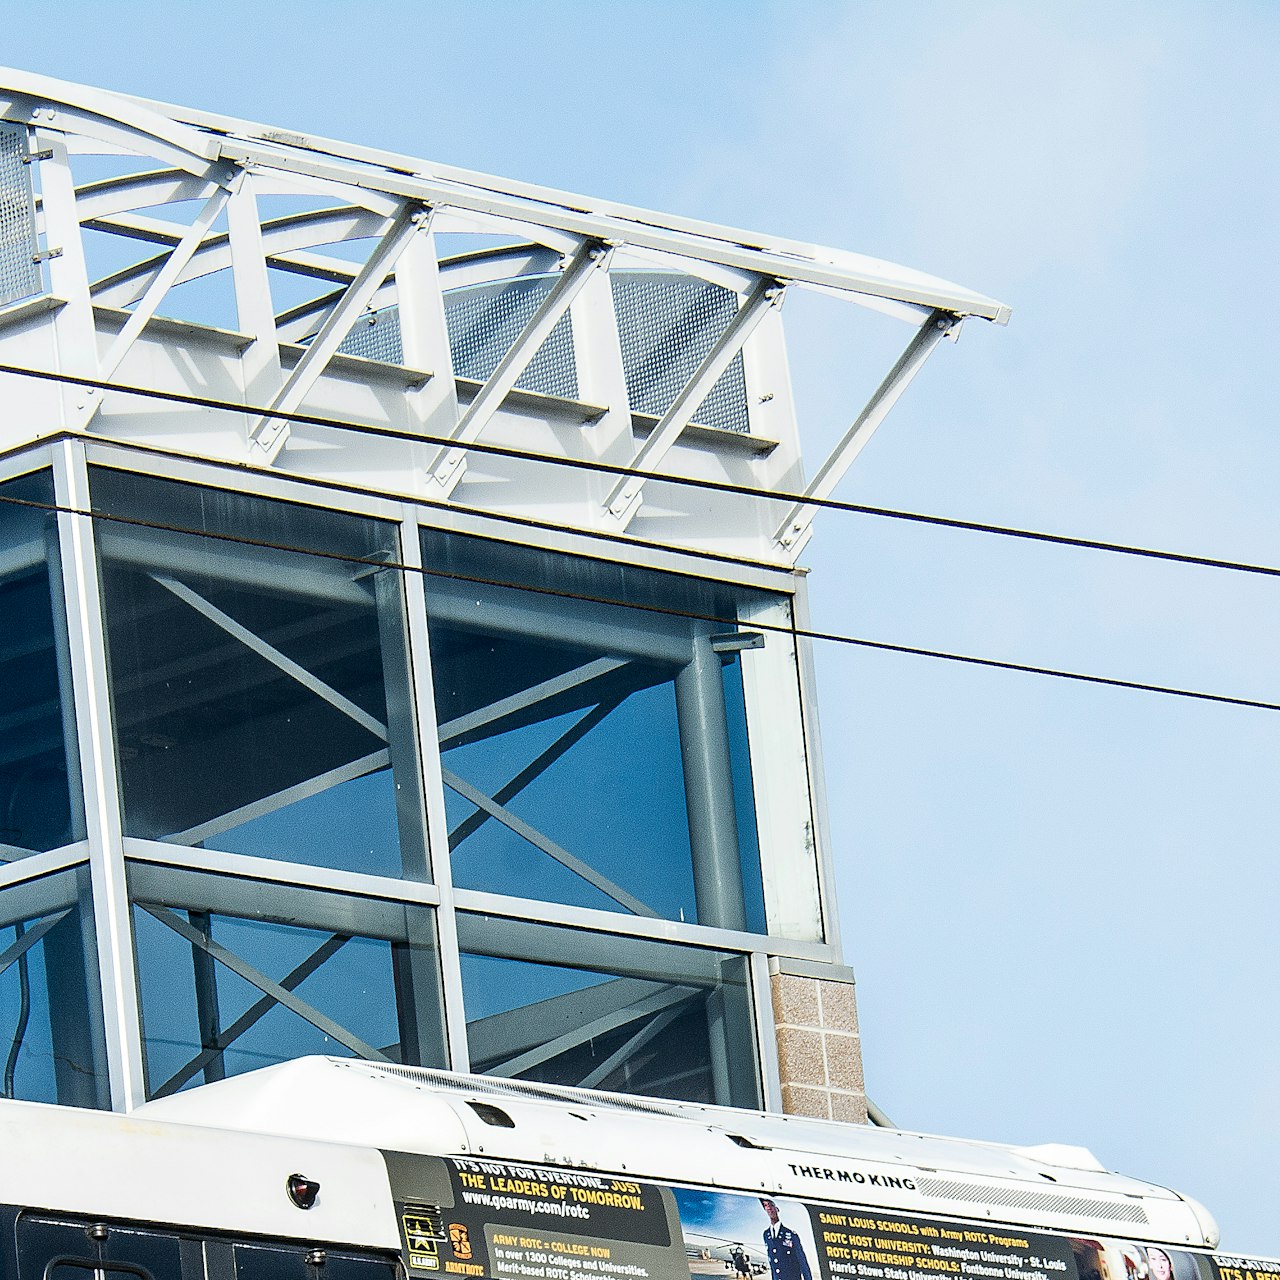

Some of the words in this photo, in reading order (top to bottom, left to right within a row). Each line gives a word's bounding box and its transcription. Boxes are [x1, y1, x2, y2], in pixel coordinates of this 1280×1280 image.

[452, 1160, 480, 1172] IT'S
[479, 1163, 507, 1176] NOT
[507, 1166, 536, 1180] FOR
[535, 1170, 609, 1190] EVERYONE.
[611, 1180, 641, 1194] JUST
[459, 1173, 486, 1189] THE
[490, 1177, 548, 1197] LEADERS
[551, 1185, 567, 1199] OF
[569, 1187, 645, 1210] TOMORROW.
[787, 1164, 865, 1184] THERMO
[867, 1174, 916, 1190] KING
[462, 1191, 590, 1219] www.goarmy.com/rotc
[819, 1213, 846, 1226] SAINT
[848, 1217, 876, 1230] LOUIS
[876, 1221, 919, 1235] SCHOOLS
[920, 1227, 938, 1238] with
[940, 1229, 963, 1242] Army
[964, 1231, 988, 1243] ROTC
[988, 1234, 1029, 1248] Programs
[493, 1234, 517, 1246] ARMY
[520, 1237, 543, 1249] ROTC
[551, 1242, 589, 1256] COLLEGE
[590, 1247, 610, 1259] NOW
[823, 1232, 848, 1244] ROTC
[849, 1234, 872, 1247] HOST
[874, 1238, 931, 1254] UNIVERSITY:
[931, 1245, 979, 1260] Washington
[980, 1251, 1023, 1268] University
[1029, 1257, 1043, 1268] St.
[1043, 1258, 1067, 1271] Louis
[826, 1246, 850, 1259] ROTC
[851, 1250, 914, 1266] PARTNERSHIP
[915, 1257, 960, 1272] SCHOOLS:
[961, 1262, 1004, 1277] Fontbonne
[494, 1247, 504, 1258] In
[505, 1251, 523, 1260] over
[524, 1251, 547, 1264] 1300
[548, 1254, 581, 1269] Colleges
[582, 1260, 597, 1271] and
[598, 1260, 649, 1277] Universities.
[496, 1261, 545, 1277] Merit-based
[546, 1267, 569, 1280] ROTC
[829, 1261, 857, 1275] Harris
[857, 1264, 883, 1277] Stowe
[884, 1268, 908, 1280] State
